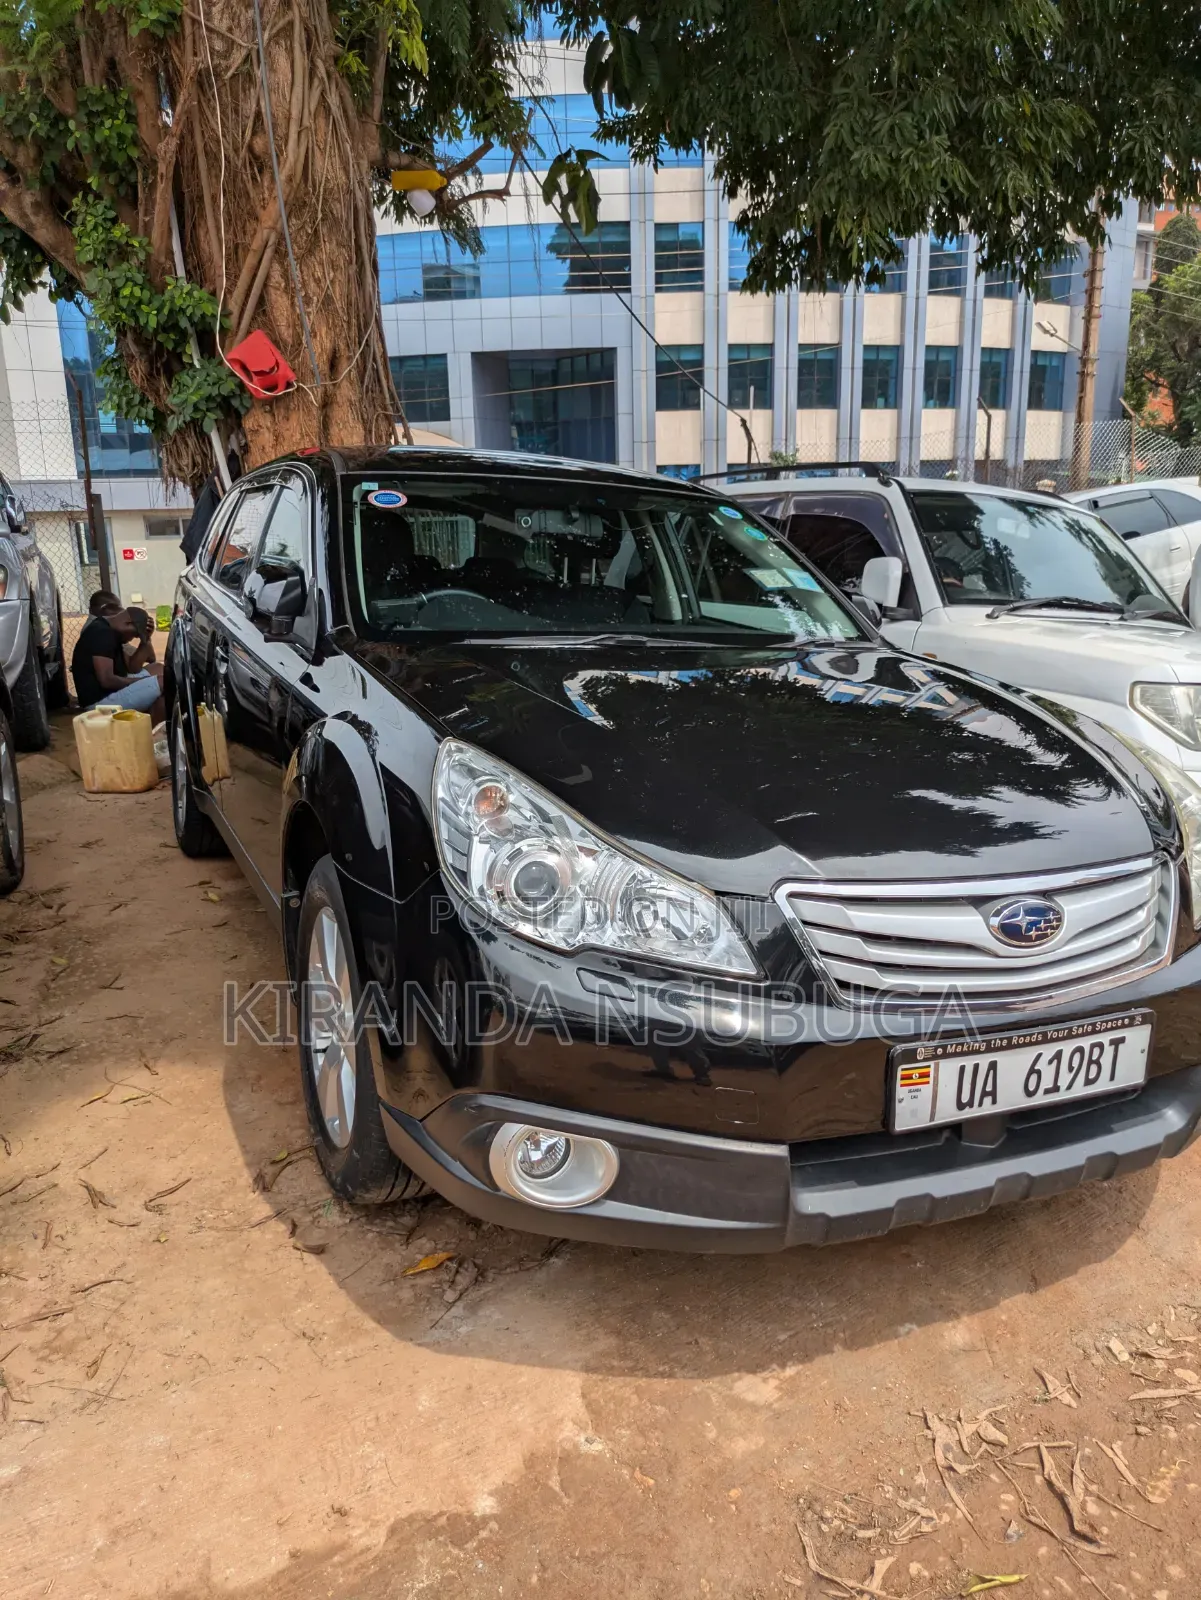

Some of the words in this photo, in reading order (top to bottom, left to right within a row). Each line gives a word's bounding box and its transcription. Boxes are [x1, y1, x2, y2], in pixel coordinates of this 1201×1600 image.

[946, 1041, 987, 1053] Making
[990, 1037, 1008, 1047] the
[1011, 1033, 1043, 1045] Roads
[1047, 1029, 1068, 1040] Your
[1071, 1025, 1093, 1035] Safe
[1095, 1019, 1122, 1031] Space
[956, 1059, 998, 1111] UA
[1023, 1036, 1126, 1098] 619BT
